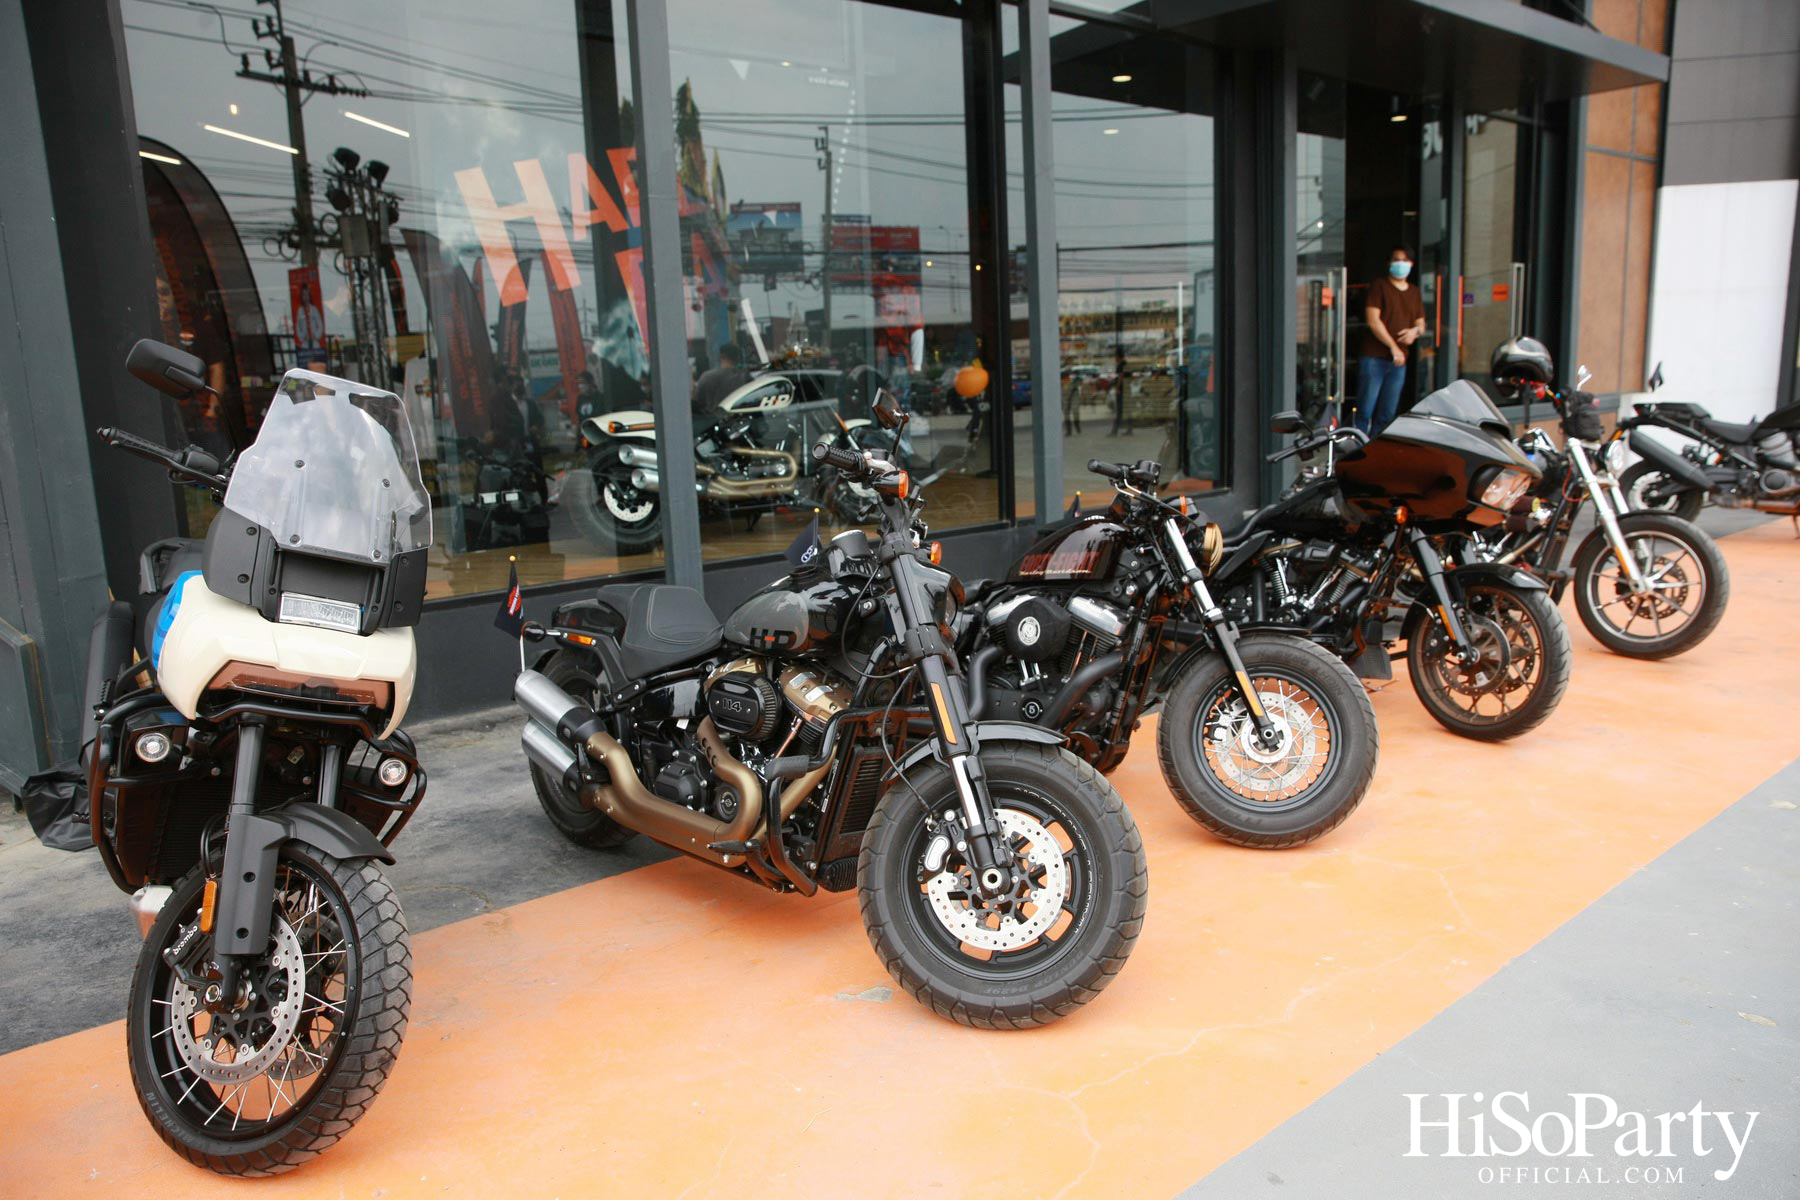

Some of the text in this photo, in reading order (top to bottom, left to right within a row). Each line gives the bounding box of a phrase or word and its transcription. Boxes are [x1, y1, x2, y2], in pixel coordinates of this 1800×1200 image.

[722, 698, 742, 712] 114
[172, 926, 198, 955] brembo
[1034, 951, 1084, 988] DUNLOP
[145, 1091, 194, 1144] MICHELIN
